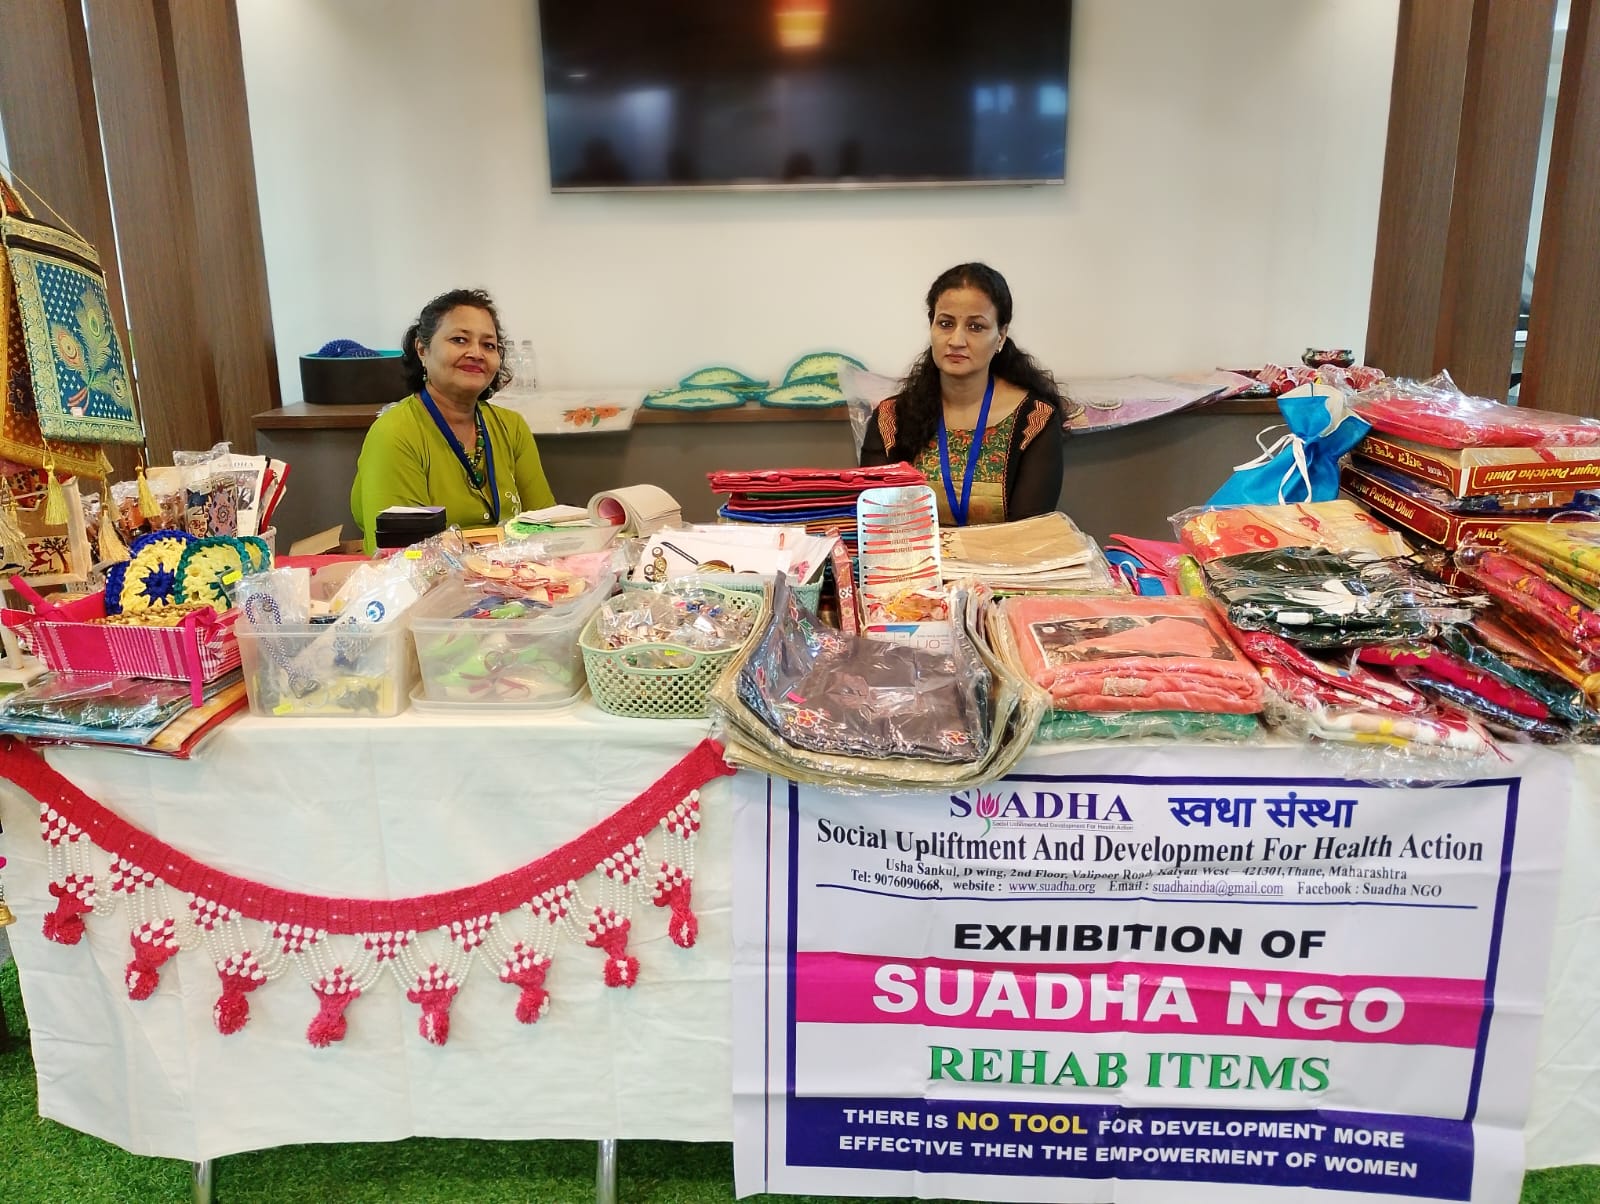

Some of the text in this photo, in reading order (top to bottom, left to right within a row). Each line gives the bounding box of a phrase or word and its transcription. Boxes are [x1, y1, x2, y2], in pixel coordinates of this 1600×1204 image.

[1483, 469, 1517, 483] Dhuti
[1519, 467, 1569, 480] Puchcha
[1473, 528, 1499, 540] May
[1168, 791, 1358, 828] स्वधा संस्था
[817, 818, 1483, 868] Social Upliftment And Development For Health Action
[851, 869, 871, 883] Tel:
[874, 873, 943, 893] 9076090668,
[953, 880, 995, 892] website
[1009, 881, 1096, 894] www.suadha.org
[1109, 881, 1142, 891] Email
[1152, 879, 1284, 896] suadhaindia@gmail.com
[1297, 881, 1352, 895] Facebook
[1362, 882, 1407, 896] Suadha
[1410, 884, 1443, 897] NGO
[886, 858, 913, 873] Usha
[917, 862, 960, 878] Sankul,
[964, 867, 973, 876] D
[976, 867, 1006, 879] wing,
[1010, 868, 1032, 878] 2nd
[1035, 869, 1068, 879] Floor,
[1328, 865, 1408, 880] Maharashtra
[954, 923, 1326, 958] EXHIBITION OF
[872, 964, 1406, 1033] SUADHA NGO
[928, 1045, 1330, 1092] REHAB ITEMS
[843, 1109, 1404, 1148] THERE IS NO TOOL FOR DEVELOPMENT MORE
[839, 1136, 1418, 1178] EFFECTIVE THEN THE EMPOWERMENT OF WOMEN
